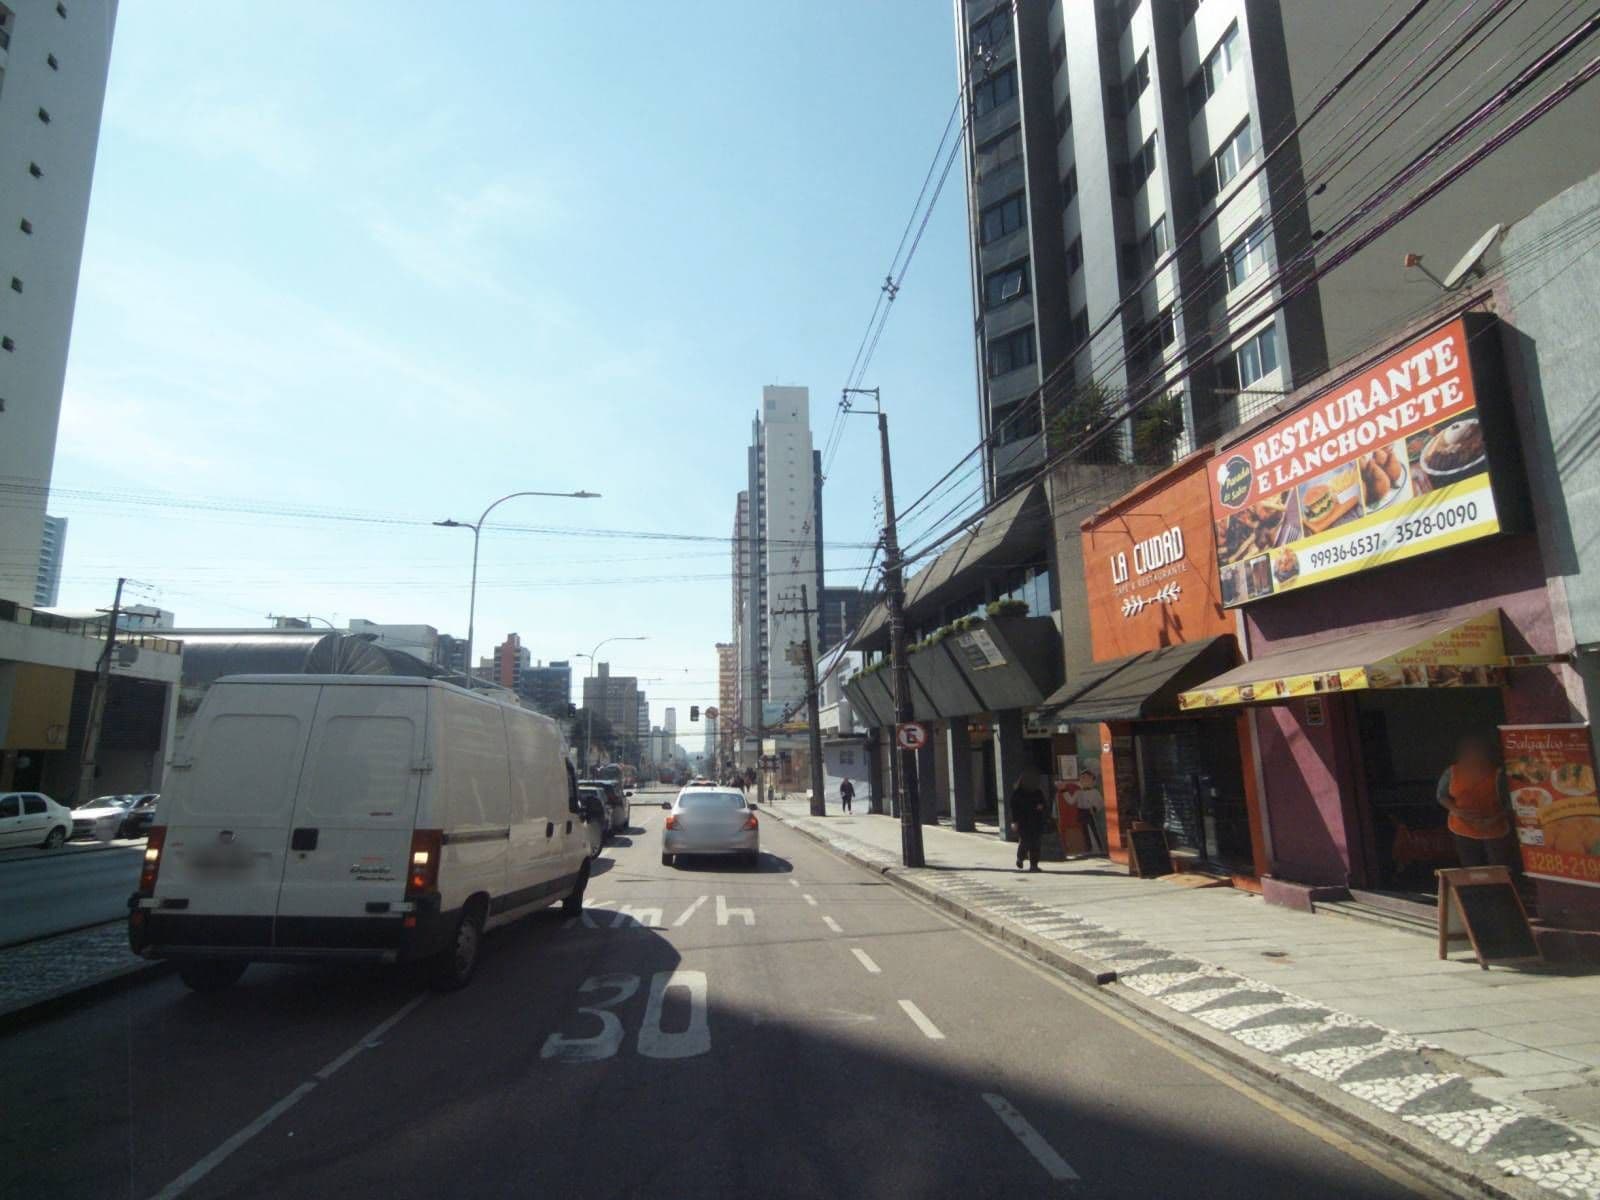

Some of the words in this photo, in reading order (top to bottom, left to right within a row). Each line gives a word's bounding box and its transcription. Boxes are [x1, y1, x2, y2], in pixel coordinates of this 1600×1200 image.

[1252, 336, 1459, 470] RESTAURANTE
[1257, 472, 1272, 495] E
[1274, 376, 1464, 486] LANCHONETE
[1110, 551, 1129, 585] LA
[1133, 525, 1185, 576] CIUDAD
[1310, 532, 1382, 569] 99936-6537
[1395, 501, 1478, 544] 3528-0090
[1504, 732, 1565, 753] Salgados
[540, 969, 713, 1062] 30
